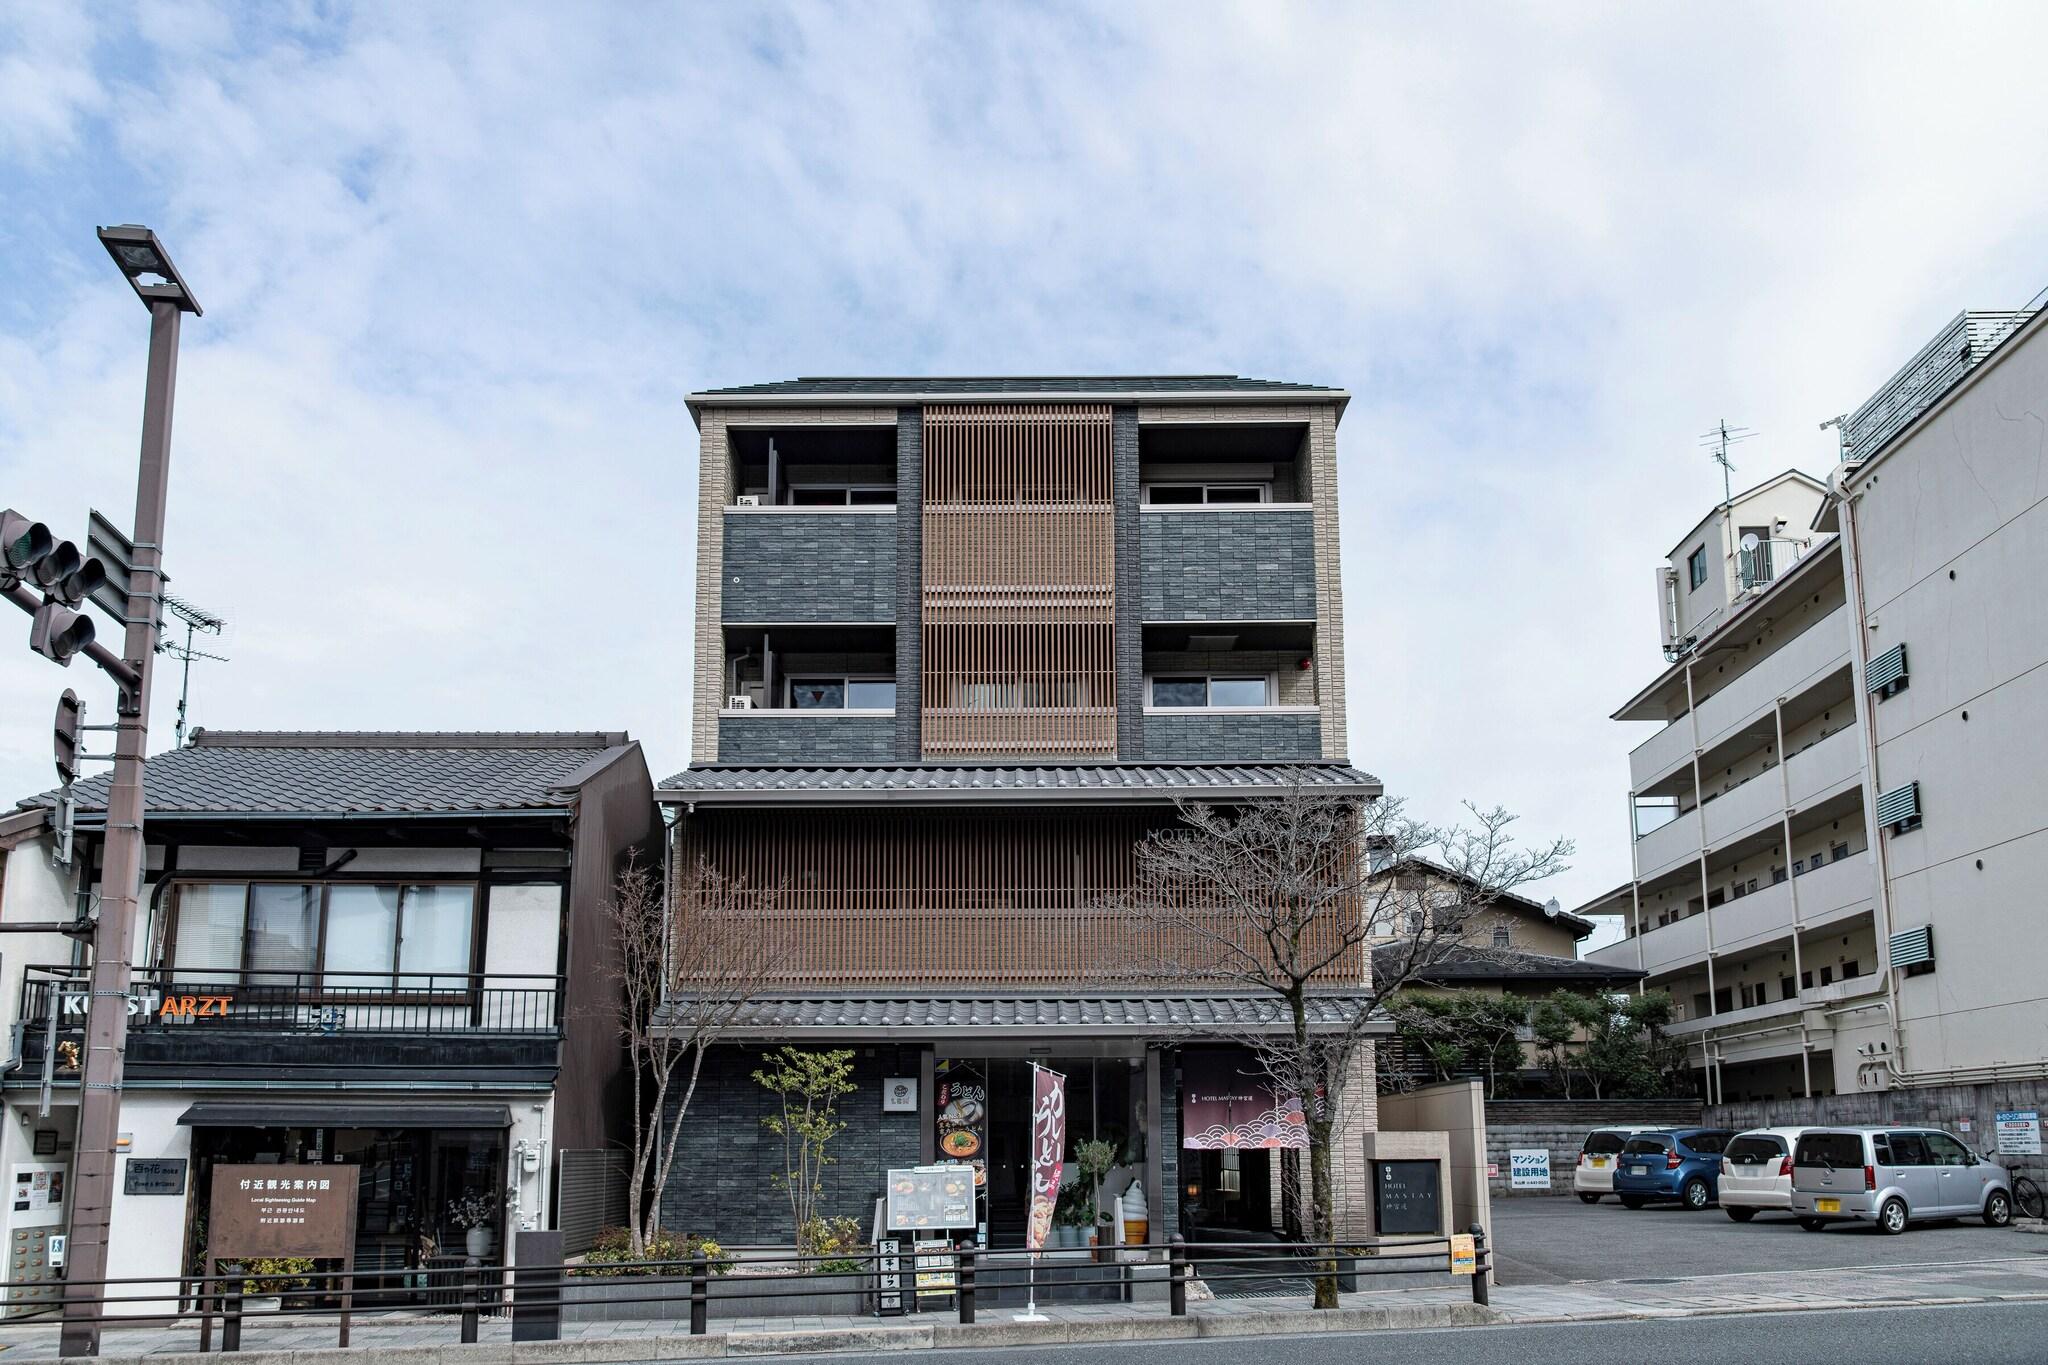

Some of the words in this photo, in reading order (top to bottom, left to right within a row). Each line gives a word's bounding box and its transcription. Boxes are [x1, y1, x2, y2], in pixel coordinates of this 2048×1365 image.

[63, 995, 158, 1016] KST
[159, 996, 233, 1016] ARZT
[950, 1081, 985, 1102] うどん
[1512, 1155, 1547, 1164] マンション
[1513, 1167, 1548, 1176] 建設用地
[240, 1179, 330, 1190] 付近観光案内図
